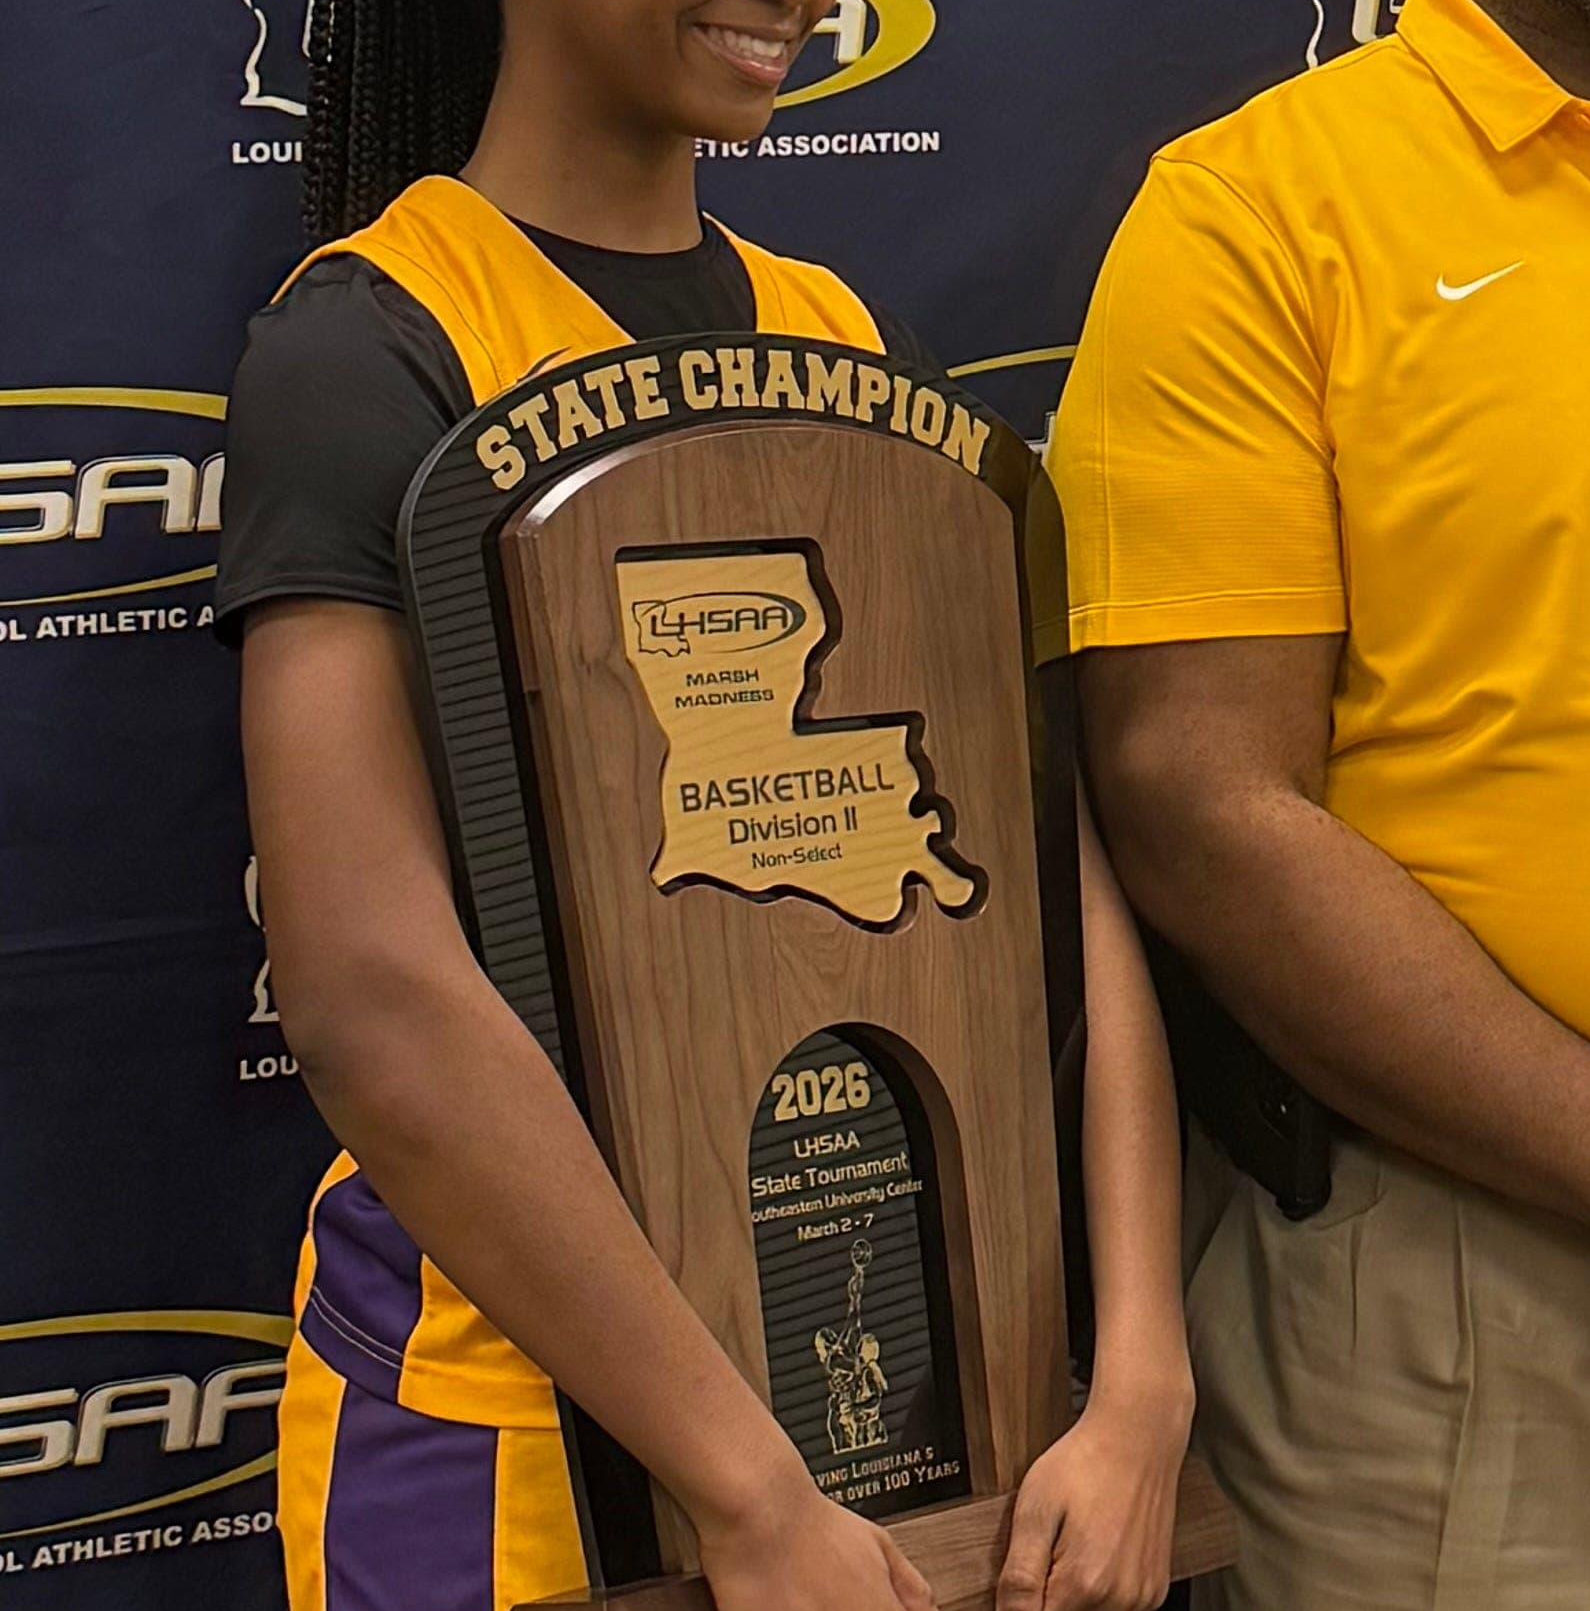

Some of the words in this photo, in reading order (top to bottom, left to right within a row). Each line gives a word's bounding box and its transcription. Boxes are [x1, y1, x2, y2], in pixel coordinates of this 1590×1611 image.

[757, 131, 940, 157] ASSOCIATION
[475, 354, 671, 490] STATE
[678, 346, 992, 476] CHAMPION
[35, 606, 189, 639] ATHLETIC
[650, 605, 790, 638] LHSAA
[686, 668, 760, 688] MARSH
[674, 689, 775, 709] MADNESS
[680, 763, 895, 813] BASKETBALL
[728, 812, 837, 846] Division
[843, 806, 858, 831] II
[751, 843, 843, 870] Non-Select
[771, 1061, 872, 1123] 2026
[794, 1130, 861, 1159] LHSAA
[750, 1175, 802, 1198] State
[805, 1150, 910, 1188] Tournament
[751, 1198, 823, 1224] outheastern
[840, 1217, 853, 1231] 2
[862, 1213, 875, 1229] 7
[884, 1470, 911, 1492] 100
[913, 1460, 961, 1484] YEARS
[31, 1525, 182, 1568] ATHLETIC
